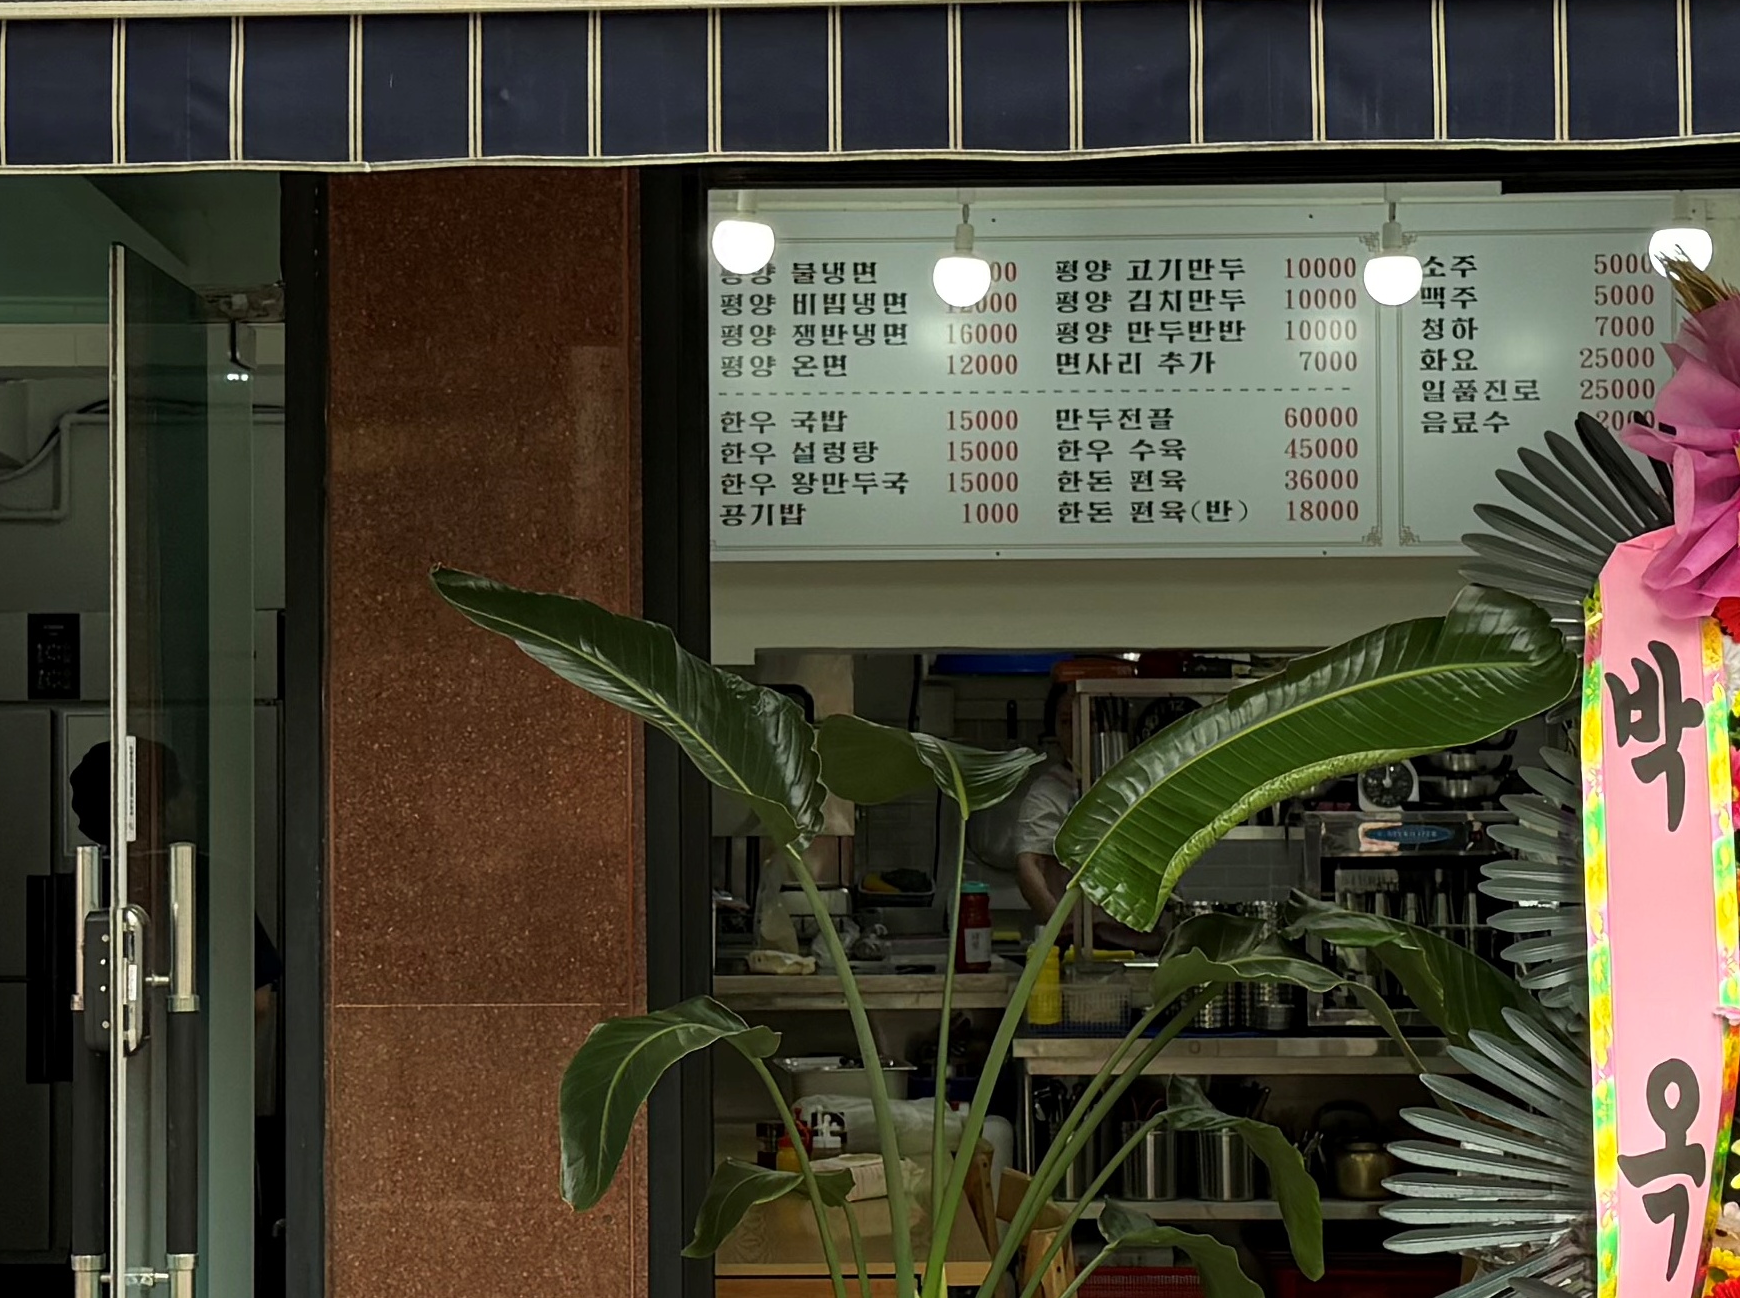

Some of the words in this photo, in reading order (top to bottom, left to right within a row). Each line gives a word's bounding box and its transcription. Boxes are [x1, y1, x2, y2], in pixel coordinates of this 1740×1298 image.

[792, 262, 876, 284] 물냉면
[1056, 260, 1111, 282] 평양
[1127, 259, 1245, 281] 고기만두
[1284, 258, 1356, 278] 10000
[1424, 255, 1477, 278] 소주
[721, 294, 775, 316] 평양
[793, 293, 906, 315] 비빔냉면
[1057, 291, 1111, 313] 평양
[1129, 290, 1245, 312] 김치만두
[1284, 289, 1356, 309] 10000
[1421, 286, 1477, 309] 맥주
[1595, 285, 1654, 305] 5000
[721, 324, 776, 346] 평양
[793, 324, 907, 346] 쟁반냉면
[947, 323, 1018, 344] 16000
[1057, 322, 1112, 344] 평양
[1128, 320, 1245, 343] 만두반반
[1284, 320, 1356, 341] 10000
[1422, 318, 1478, 340] 청하
[1596, 316, 1654, 336] 7000
[721, 356, 776, 377] 평양
[792, 355, 846, 377] 온면
[947, 354, 1017, 374] 12000
[1057, 353, 1141, 375] 면사리
[1158, 352, 1215, 374] 추가
[1300, 352, 1357, 371] 7000
[1420, 349, 1477, 371] 화요
[1580, 347, 1654, 368] 25000
[1422, 380, 1540, 402] 일품진로
[1580, 379, 1654, 399] 25000
[721, 411, 776, 434] 한우
[791, 411, 847, 433] 국밥
[947, 410, 1018, 430] 15000
[1056, 408, 1173, 431] 만두전골
[1285, 407, 1357, 428] 60000
[1422, 411, 1510, 433] 음료수
[721, 442, 775, 465] 한우
[793, 441, 878, 463] 설렁탕
[947, 441, 1018, 461] 15000
[1058, 440, 1113, 462] 한우
[1130, 439, 1186, 461] 수육
[1285, 438, 1358, 458] 45000
[721, 473, 775, 496] 한우
[792, 472, 909, 494] 왕만두국
[947, 472, 1018, 492] 15000
[1058, 471, 1112, 492] 한돈
[1131, 470, 1186, 492] 편육
[1285, 469, 1358, 490] 36000
[720, 504, 806, 526] 공기밥
[962, 503, 1018, 523] 1000
[1058, 502, 1112, 523] 한돈
[1131, 501, 1247, 523] 편육(반)
[1286, 500, 1358, 521] 18000
